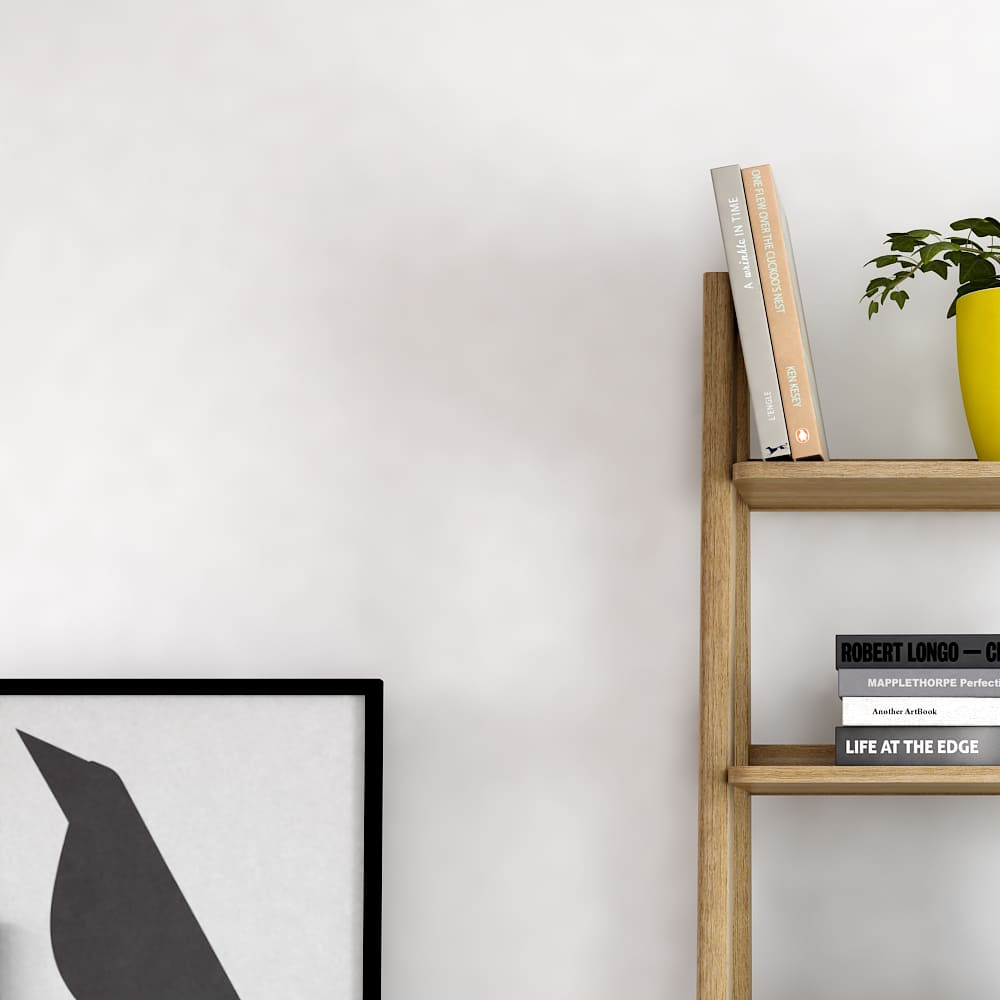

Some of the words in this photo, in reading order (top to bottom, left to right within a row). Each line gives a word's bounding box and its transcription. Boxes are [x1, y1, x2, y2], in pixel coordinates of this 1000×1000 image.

[751, 169, 763, 188] ONE
[754, 188, 768, 209] FLEW
[728, 196, 741, 222] TIME
[733, 224, 745, 236] IN
[758, 209, 771, 233] OVER
[762, 233, 775, 249] THE
[736, 237, 752, 279] wrinkle
[743, 278, 754, 289] A
[773, 292, 786, 312] NEST
[785, 365, 798, 382] KEN
[789, 383, 802, 407] KESEY
[841, 642, 903, 662] ROBERT
[907, 642, 959, 662] LONGO
[867, 678, 957, 688] MAPPLETHORPE
[845, 739, 877, 754] LIFE
[880, 739, 900, 754] AT
[903, 739, 934, 754] THE
[937, 739, 979, 754] EDGE
